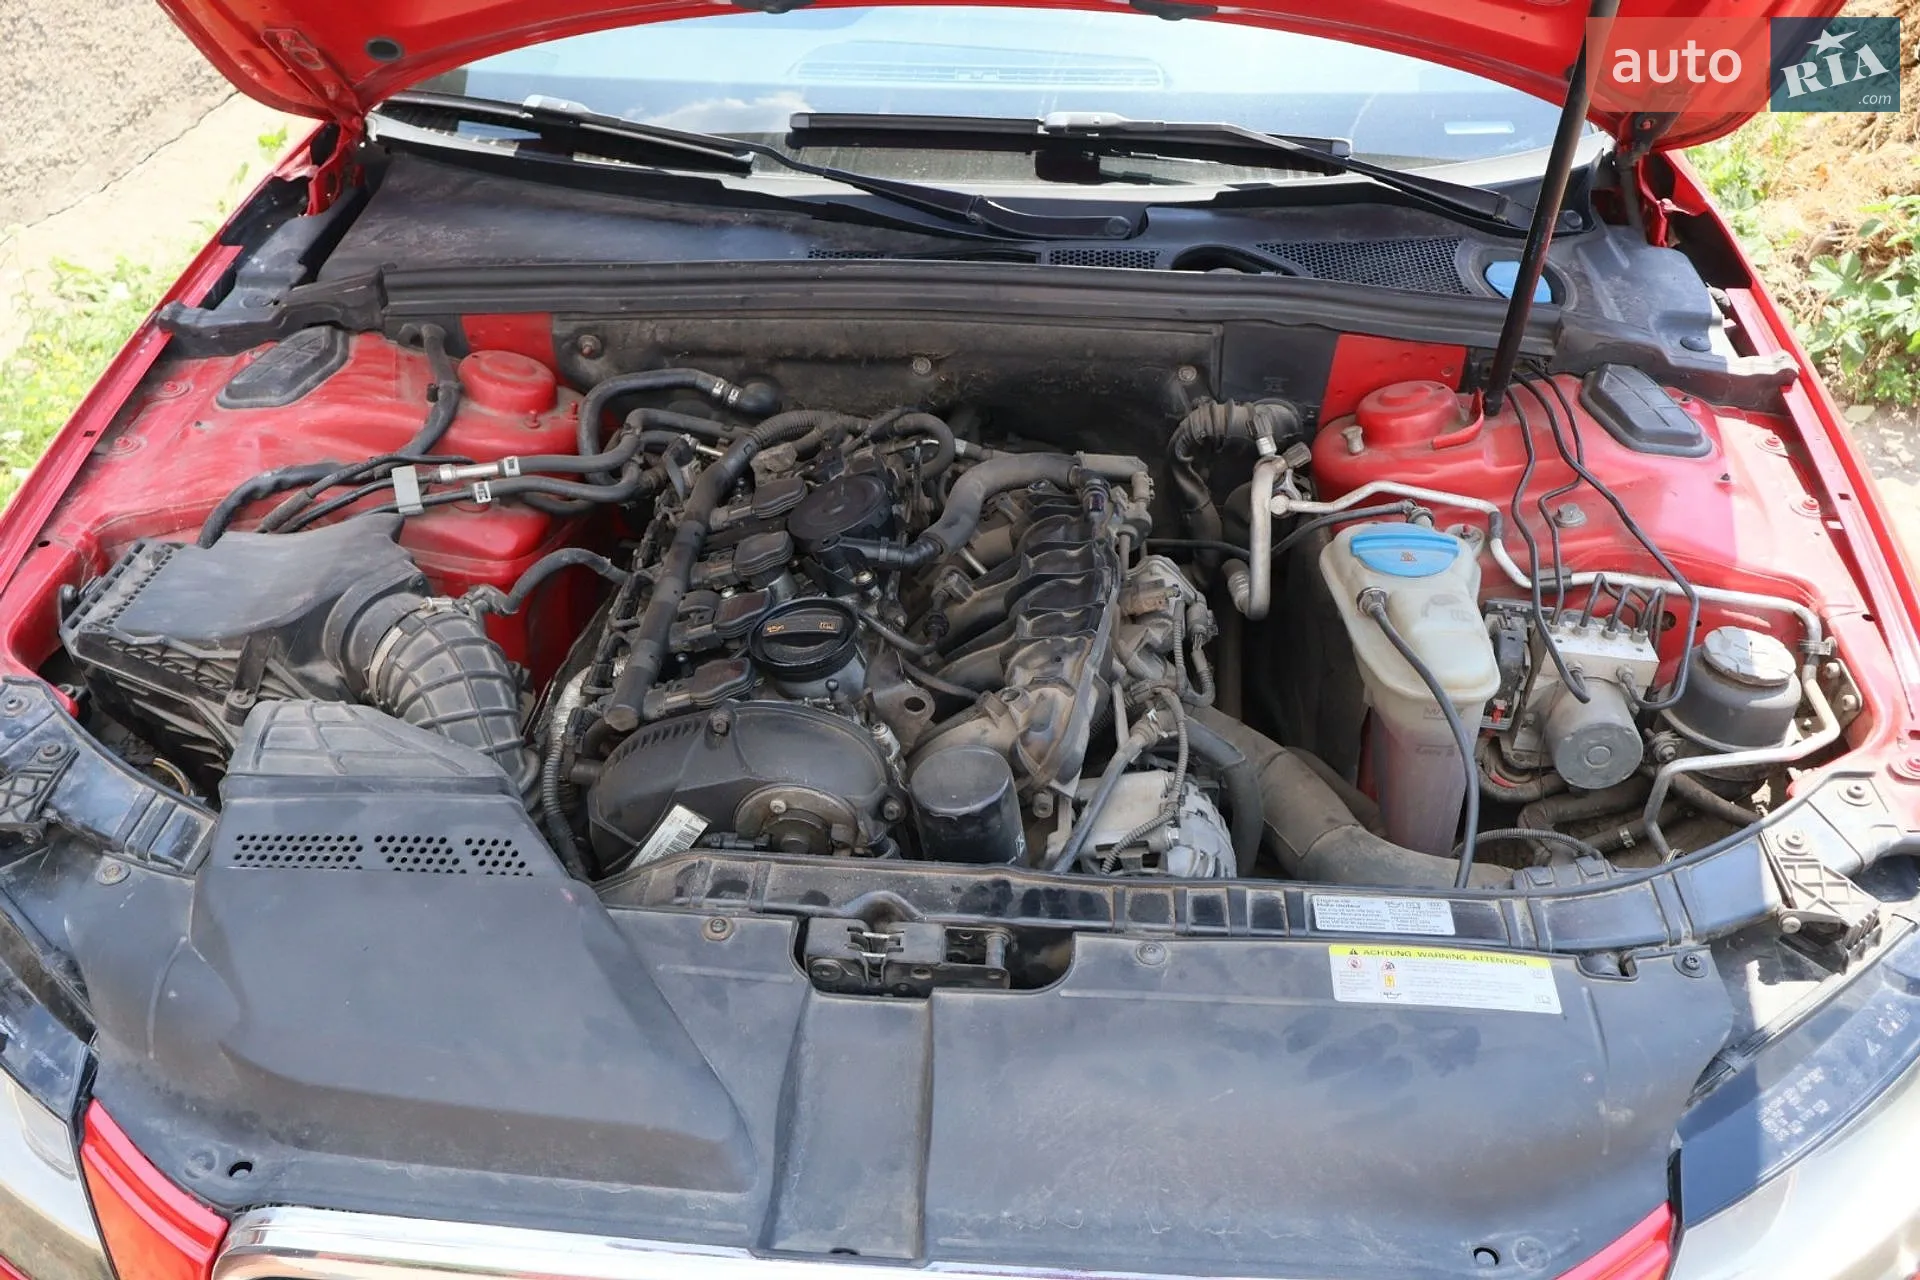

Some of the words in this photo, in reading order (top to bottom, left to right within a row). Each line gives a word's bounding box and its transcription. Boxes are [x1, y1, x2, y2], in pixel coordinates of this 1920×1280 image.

[1363, 948, 1412, 958] ACHTUNG
[1417, 951, 1467, 961] WARNING
[1472, 954, 1527, 966] ATTENTION
